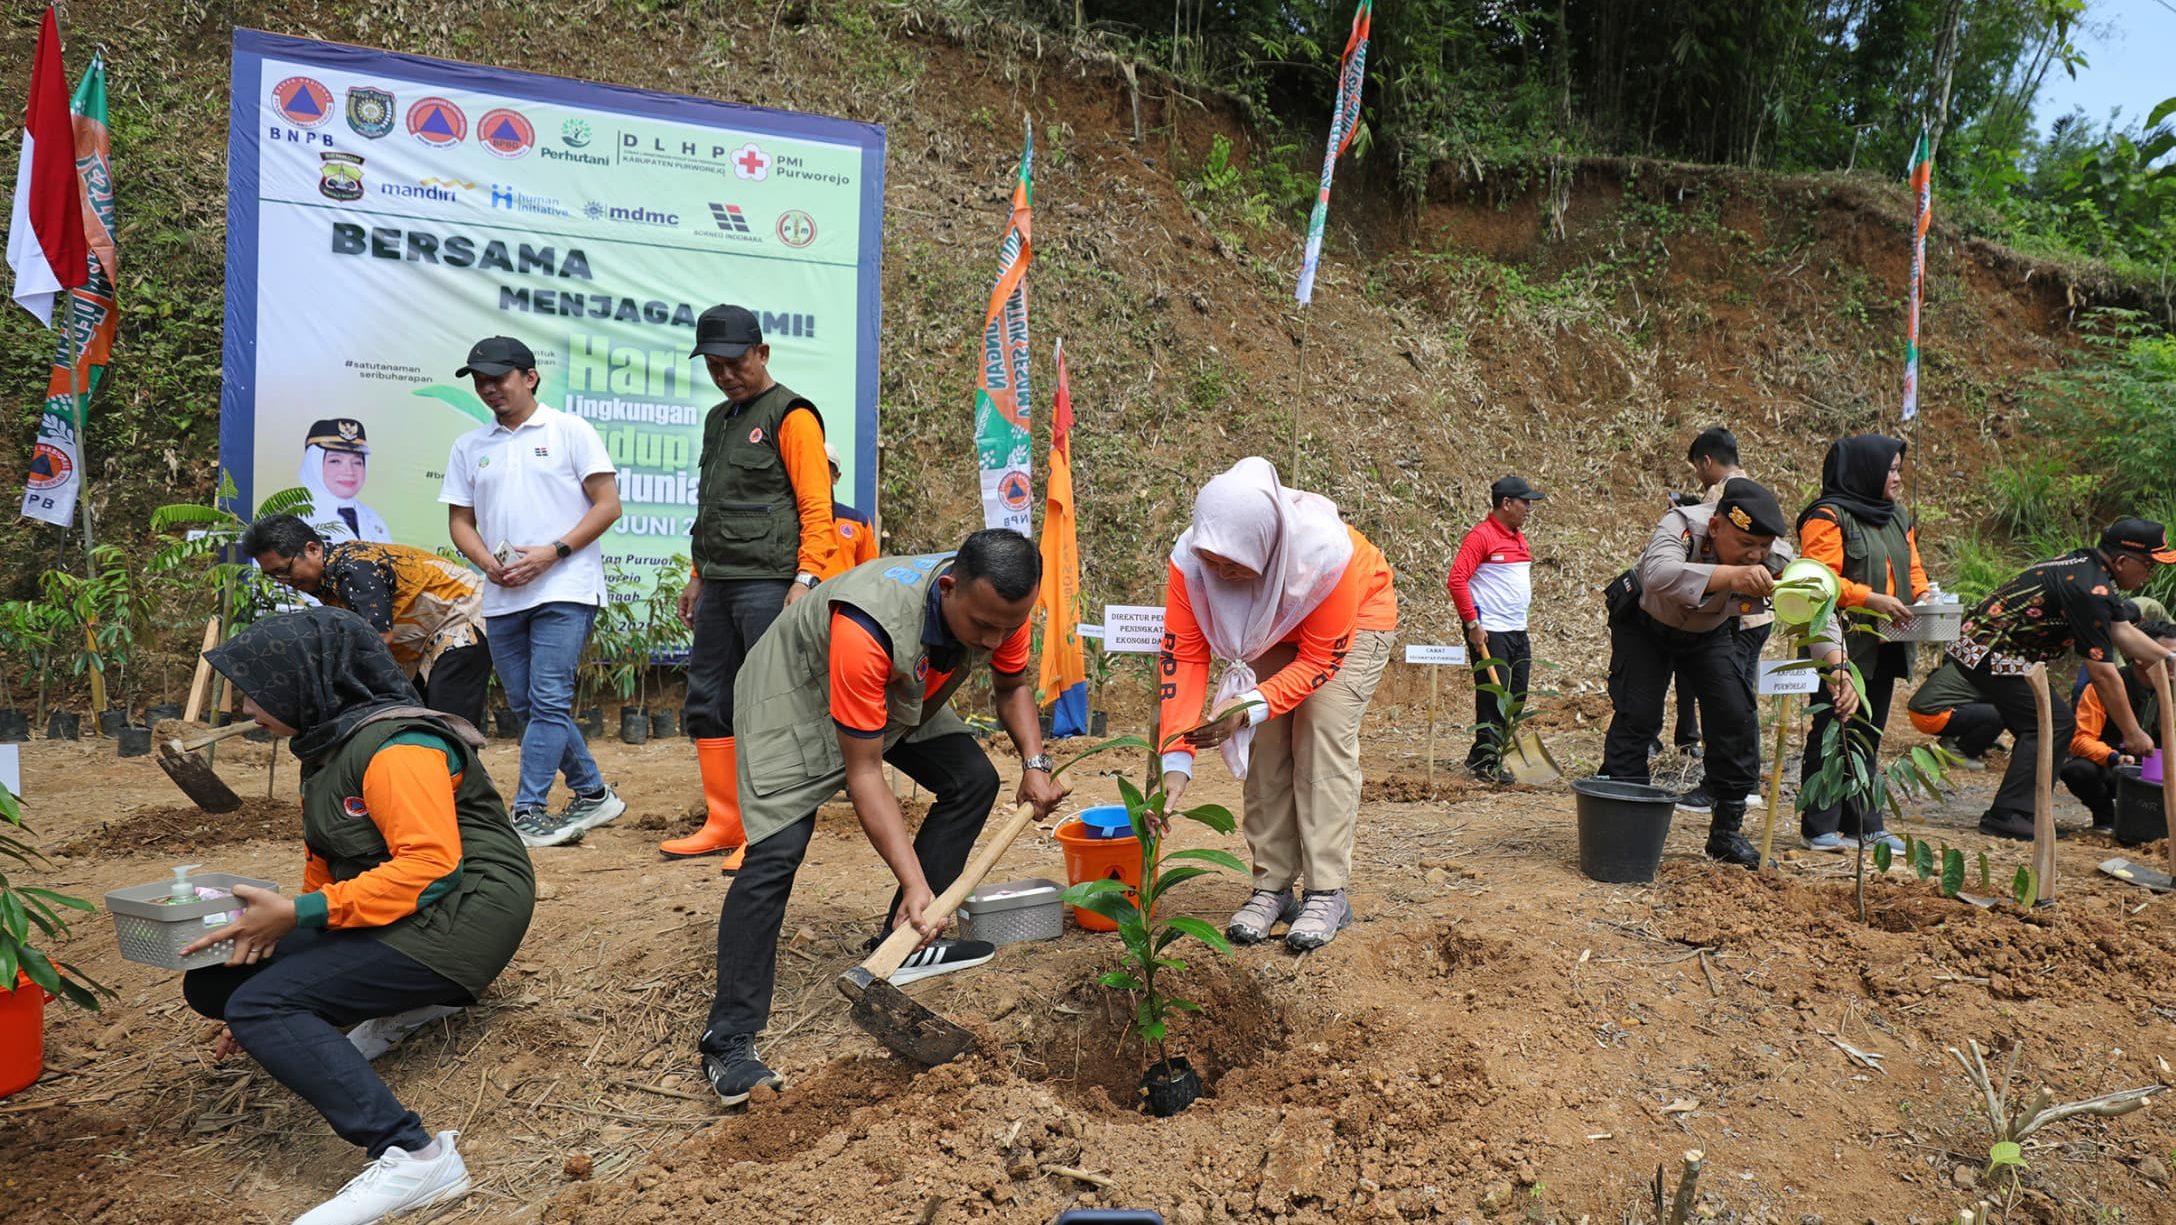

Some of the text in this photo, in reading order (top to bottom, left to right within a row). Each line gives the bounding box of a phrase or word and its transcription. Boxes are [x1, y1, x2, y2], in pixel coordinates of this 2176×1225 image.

[270, 127, 334, 147] BNPB
[541, 147, 610, 166] Perhutani
[623, 156, 674, 168] KABUPATEN
[777, 155, 803, 168] PMI
[776, 167, 850, 186] Purworejo
[381, 182, 456, 202] mandiri
[518, 192, 560, 206] human
[518, 202, 569, 217] initiative
[609, 206, 679, 225] mdmc
[332, 222, 593, 280] BERSAMA
[500, 285, 815, 338] MENJAGA MI!
[344, 360, 421, 374] #satutanaman
[568, 333, 692, 398] Hari
[359, 370, 433, 384] seribuharapan
[565, 394, 697, 425] Lingkungan
[596, 423, 690, 472] idup
[615, 468, 700, 505] dunia
[28, 493, 55, 509] PB
[614, 516, 677, 536] JUNI
[1111, 613, 1150, 621] DIREKTUR
[1120, 625, 1164, 633] PENINGKAT
[1115, 637, 1150, 645] EKONOMI
